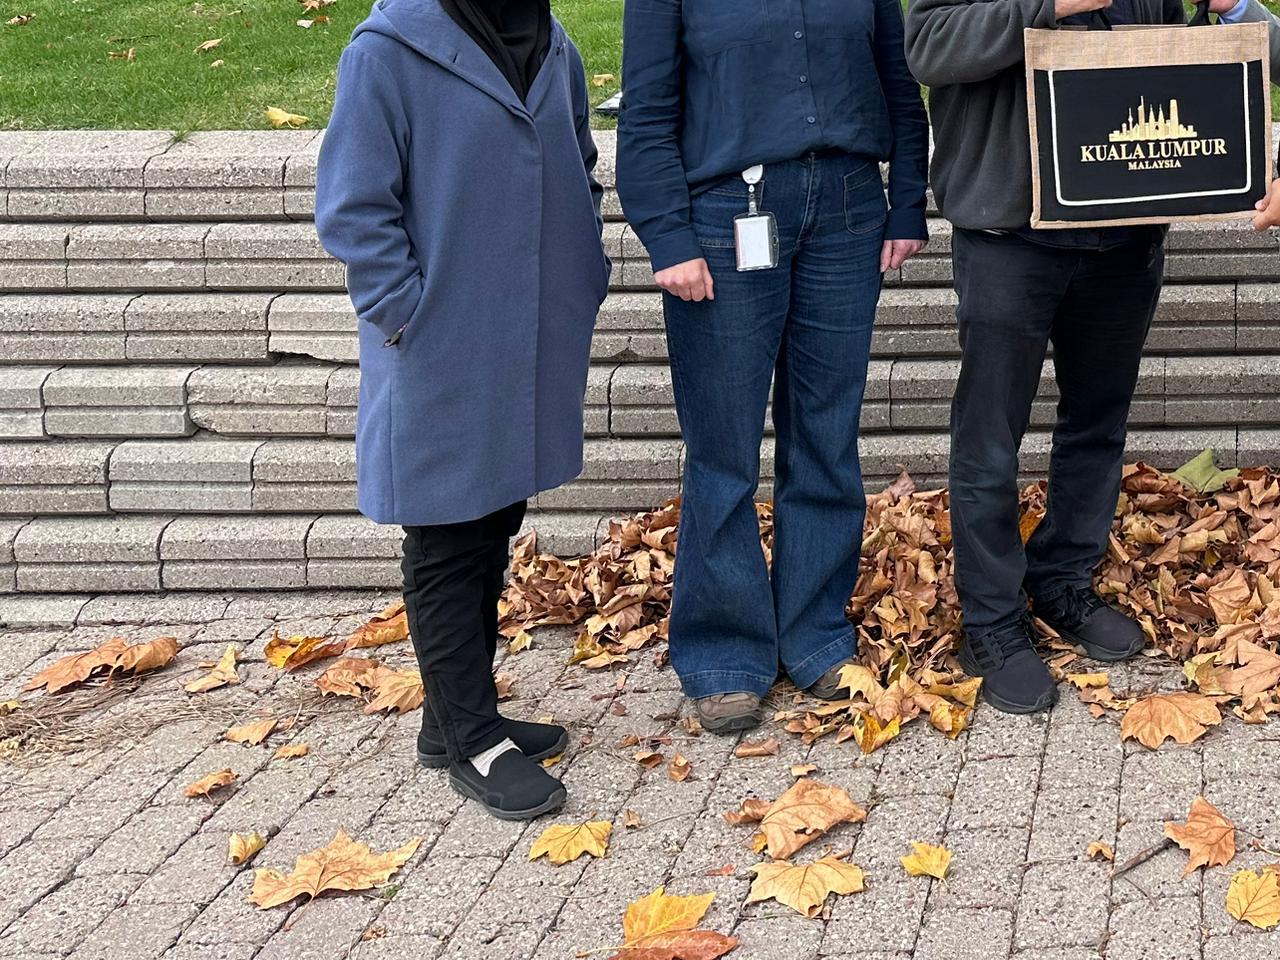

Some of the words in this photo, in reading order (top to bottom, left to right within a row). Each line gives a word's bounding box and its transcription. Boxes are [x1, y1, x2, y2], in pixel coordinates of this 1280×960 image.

[1080, 142, 1146, 163] KUALA
[1147, 138, 1228, 159] LUMPUR
[1127, 159, 1182, 171] MALAYSIA
